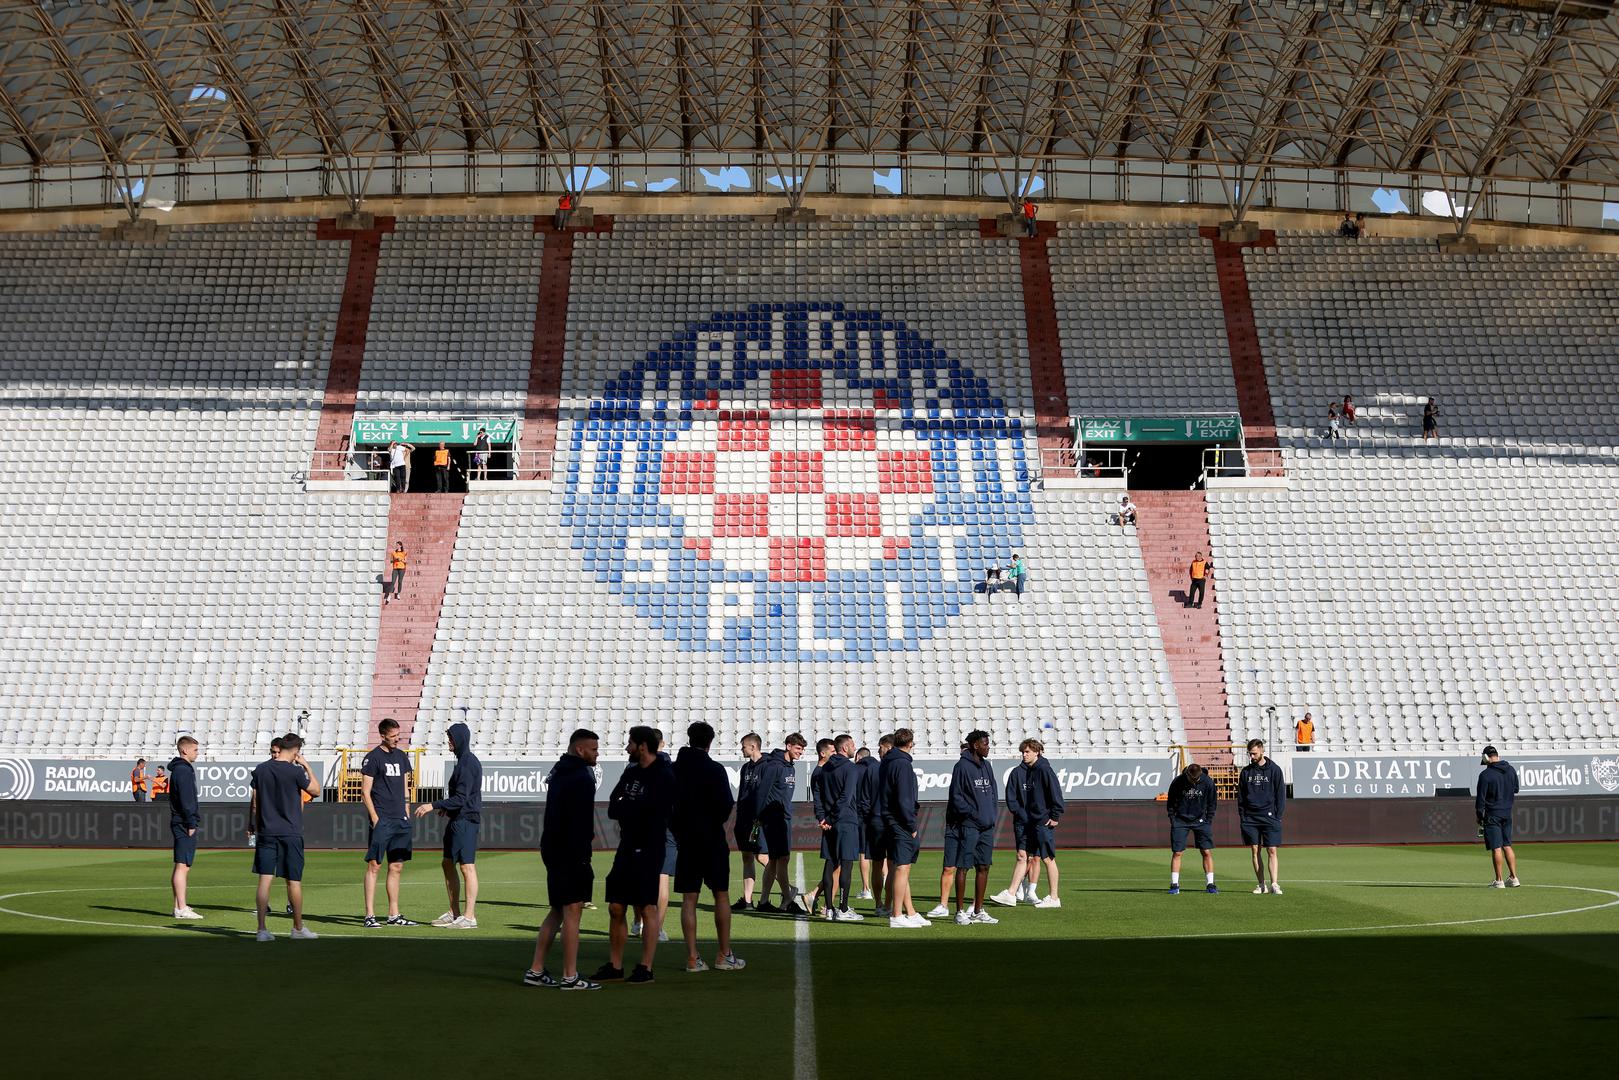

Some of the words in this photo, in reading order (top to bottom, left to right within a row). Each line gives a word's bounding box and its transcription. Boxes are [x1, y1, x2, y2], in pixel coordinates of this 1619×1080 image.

[358, 422, 398, 431] IZLAZ
[472, 422, 512, 431] IZLAZ
[1082, 420, 1120, 428] IZLAZ
[1196, 420, 1236, 428] IZLAZ
[362, 432, 393, 440] EXIT
[486, 432, 508, 440] XIT
[1086, 430, 1116, 438] EXIT
[1200, 430, 1230, 438] EXIT
[625, 525, 966, 651] SPLIT
[46, 766, 96, 779] RADIO
[1312, 760, 1452, 780] ADRIATIC
[1518, 764, 1582, 786] lovačko
[45, 780, 132, 792] DALMACIJA
[480, 770, 549, 792] arlovačk
[1599, 806, 1619, 834] F
[0, 812, 98, 840] HAJDUK
[113, 812, 162, 841] FAN
[333, 814, 434, 842] HAUK
[520, 814, 542, 842] S
